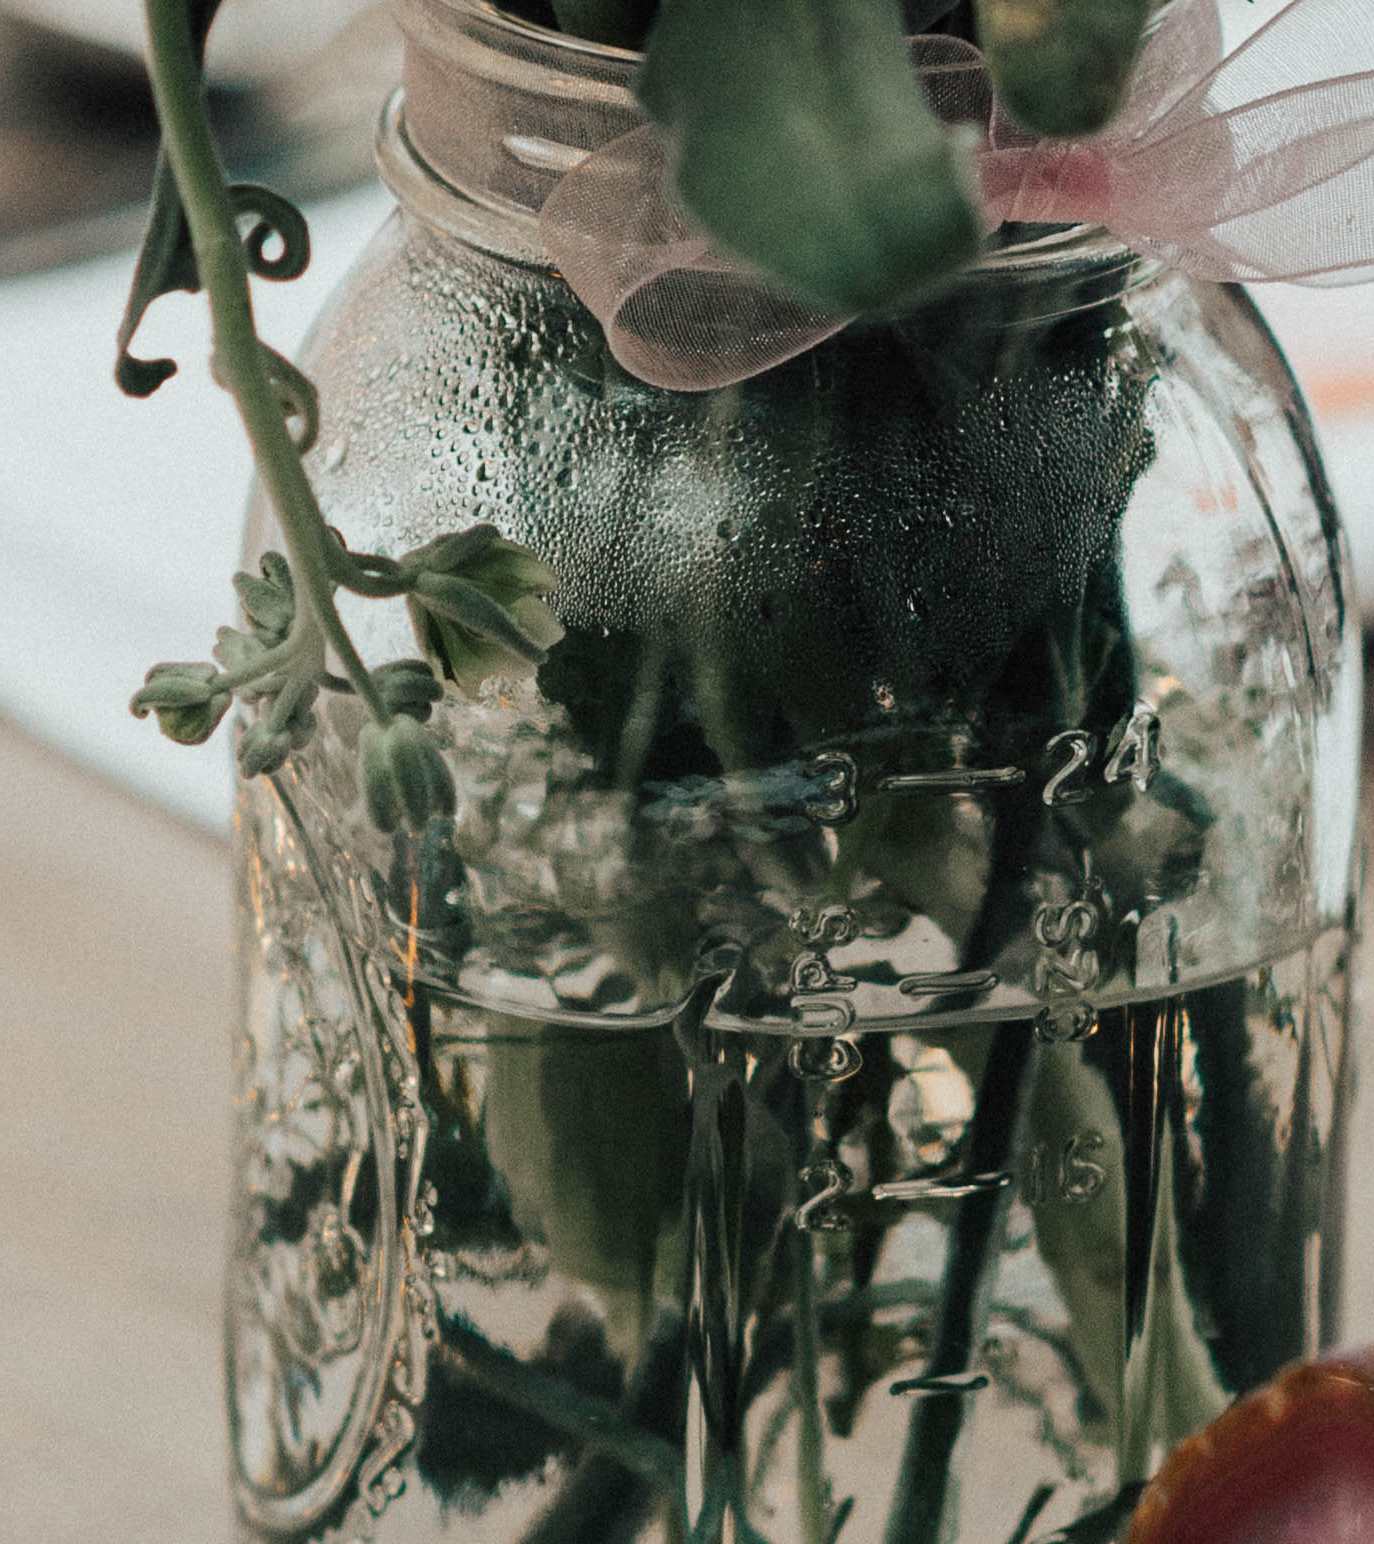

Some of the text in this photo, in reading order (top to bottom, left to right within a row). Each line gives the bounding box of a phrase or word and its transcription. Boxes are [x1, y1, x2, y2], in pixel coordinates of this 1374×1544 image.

[804, 710, 1162, 820] 3 24
[788, 905, 863, 1079] CUPS
[794, 1132, 1106, 1232] 2 16
